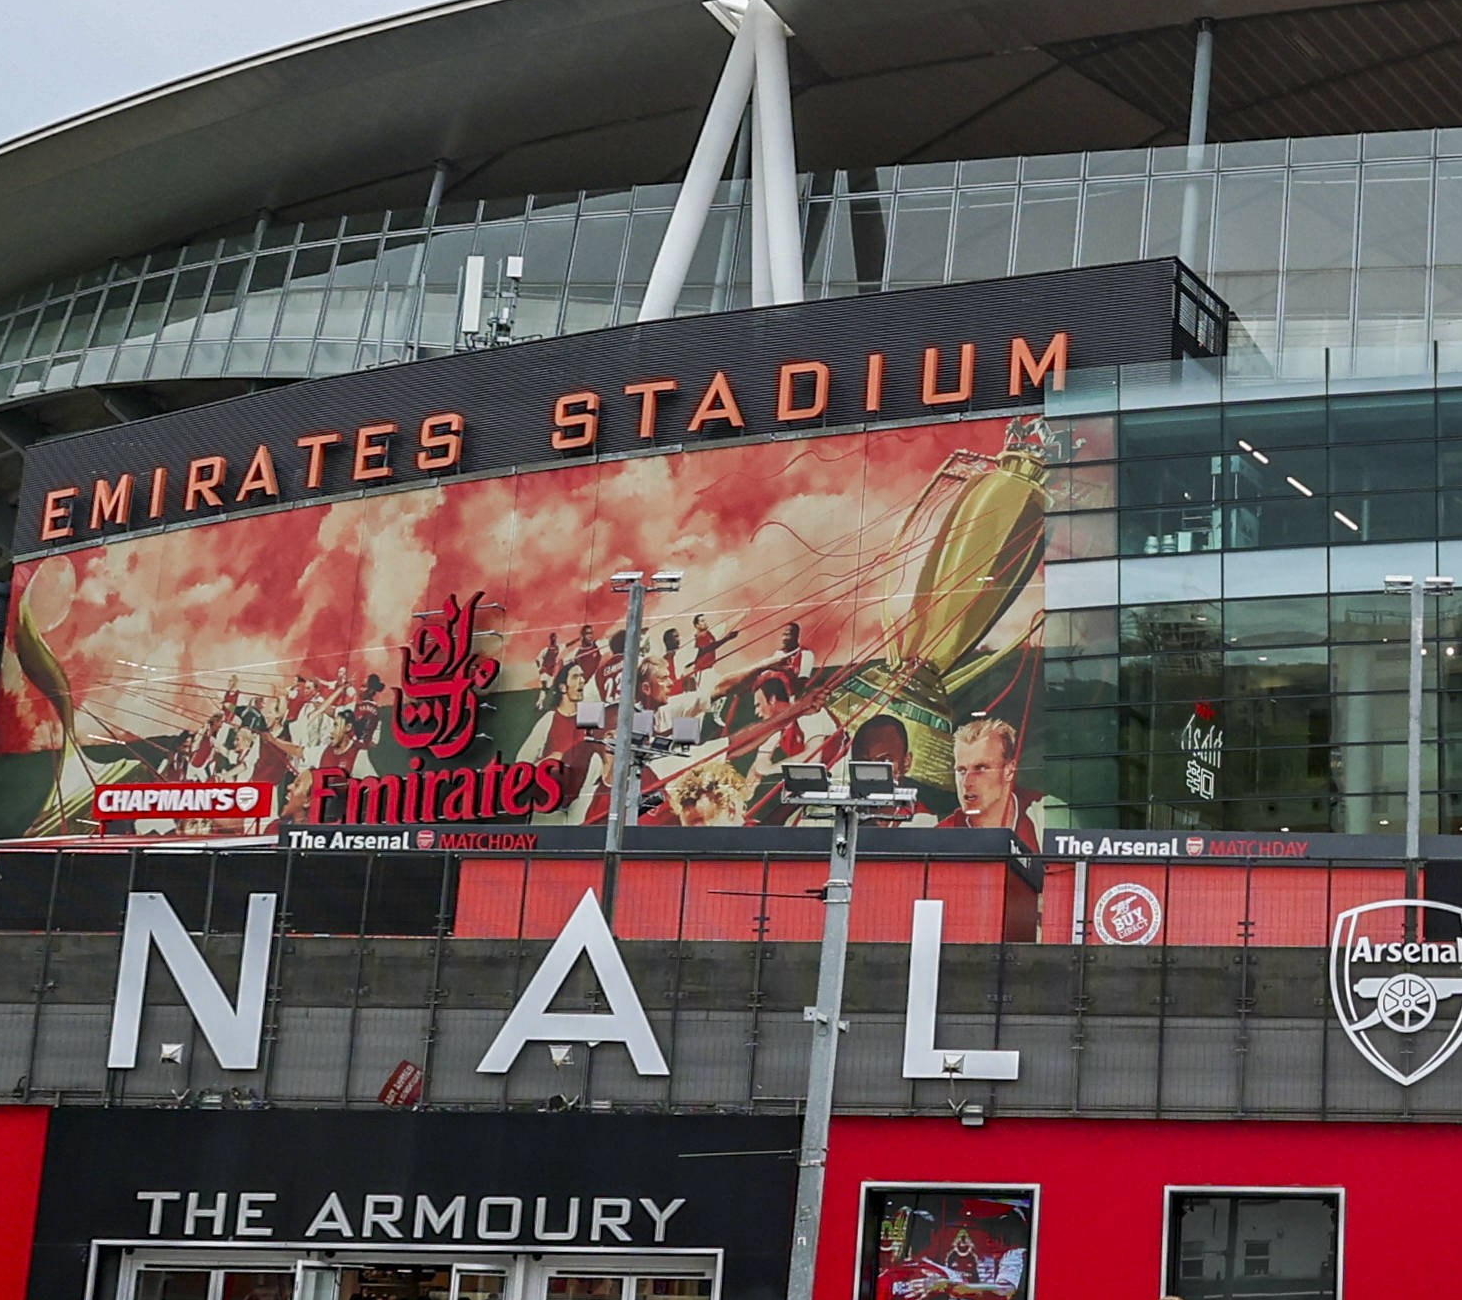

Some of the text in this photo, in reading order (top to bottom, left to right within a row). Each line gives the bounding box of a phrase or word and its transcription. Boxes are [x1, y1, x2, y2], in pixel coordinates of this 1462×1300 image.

[40, 332, 1070, 541] EMIRATES STADIUM
[97, 788, 235, 813] CHAPMAN'S
[308, 751, 564, 825] Emirates
[288, 830, 539, 851] The Arsenal MATCHDAY
[1055, 835, 1309, 857] The Arsenal MATCHDAY
[1111, 905, 1146, 933] BUY
[137, 1191, 686, 1243] THE ARMOURY
